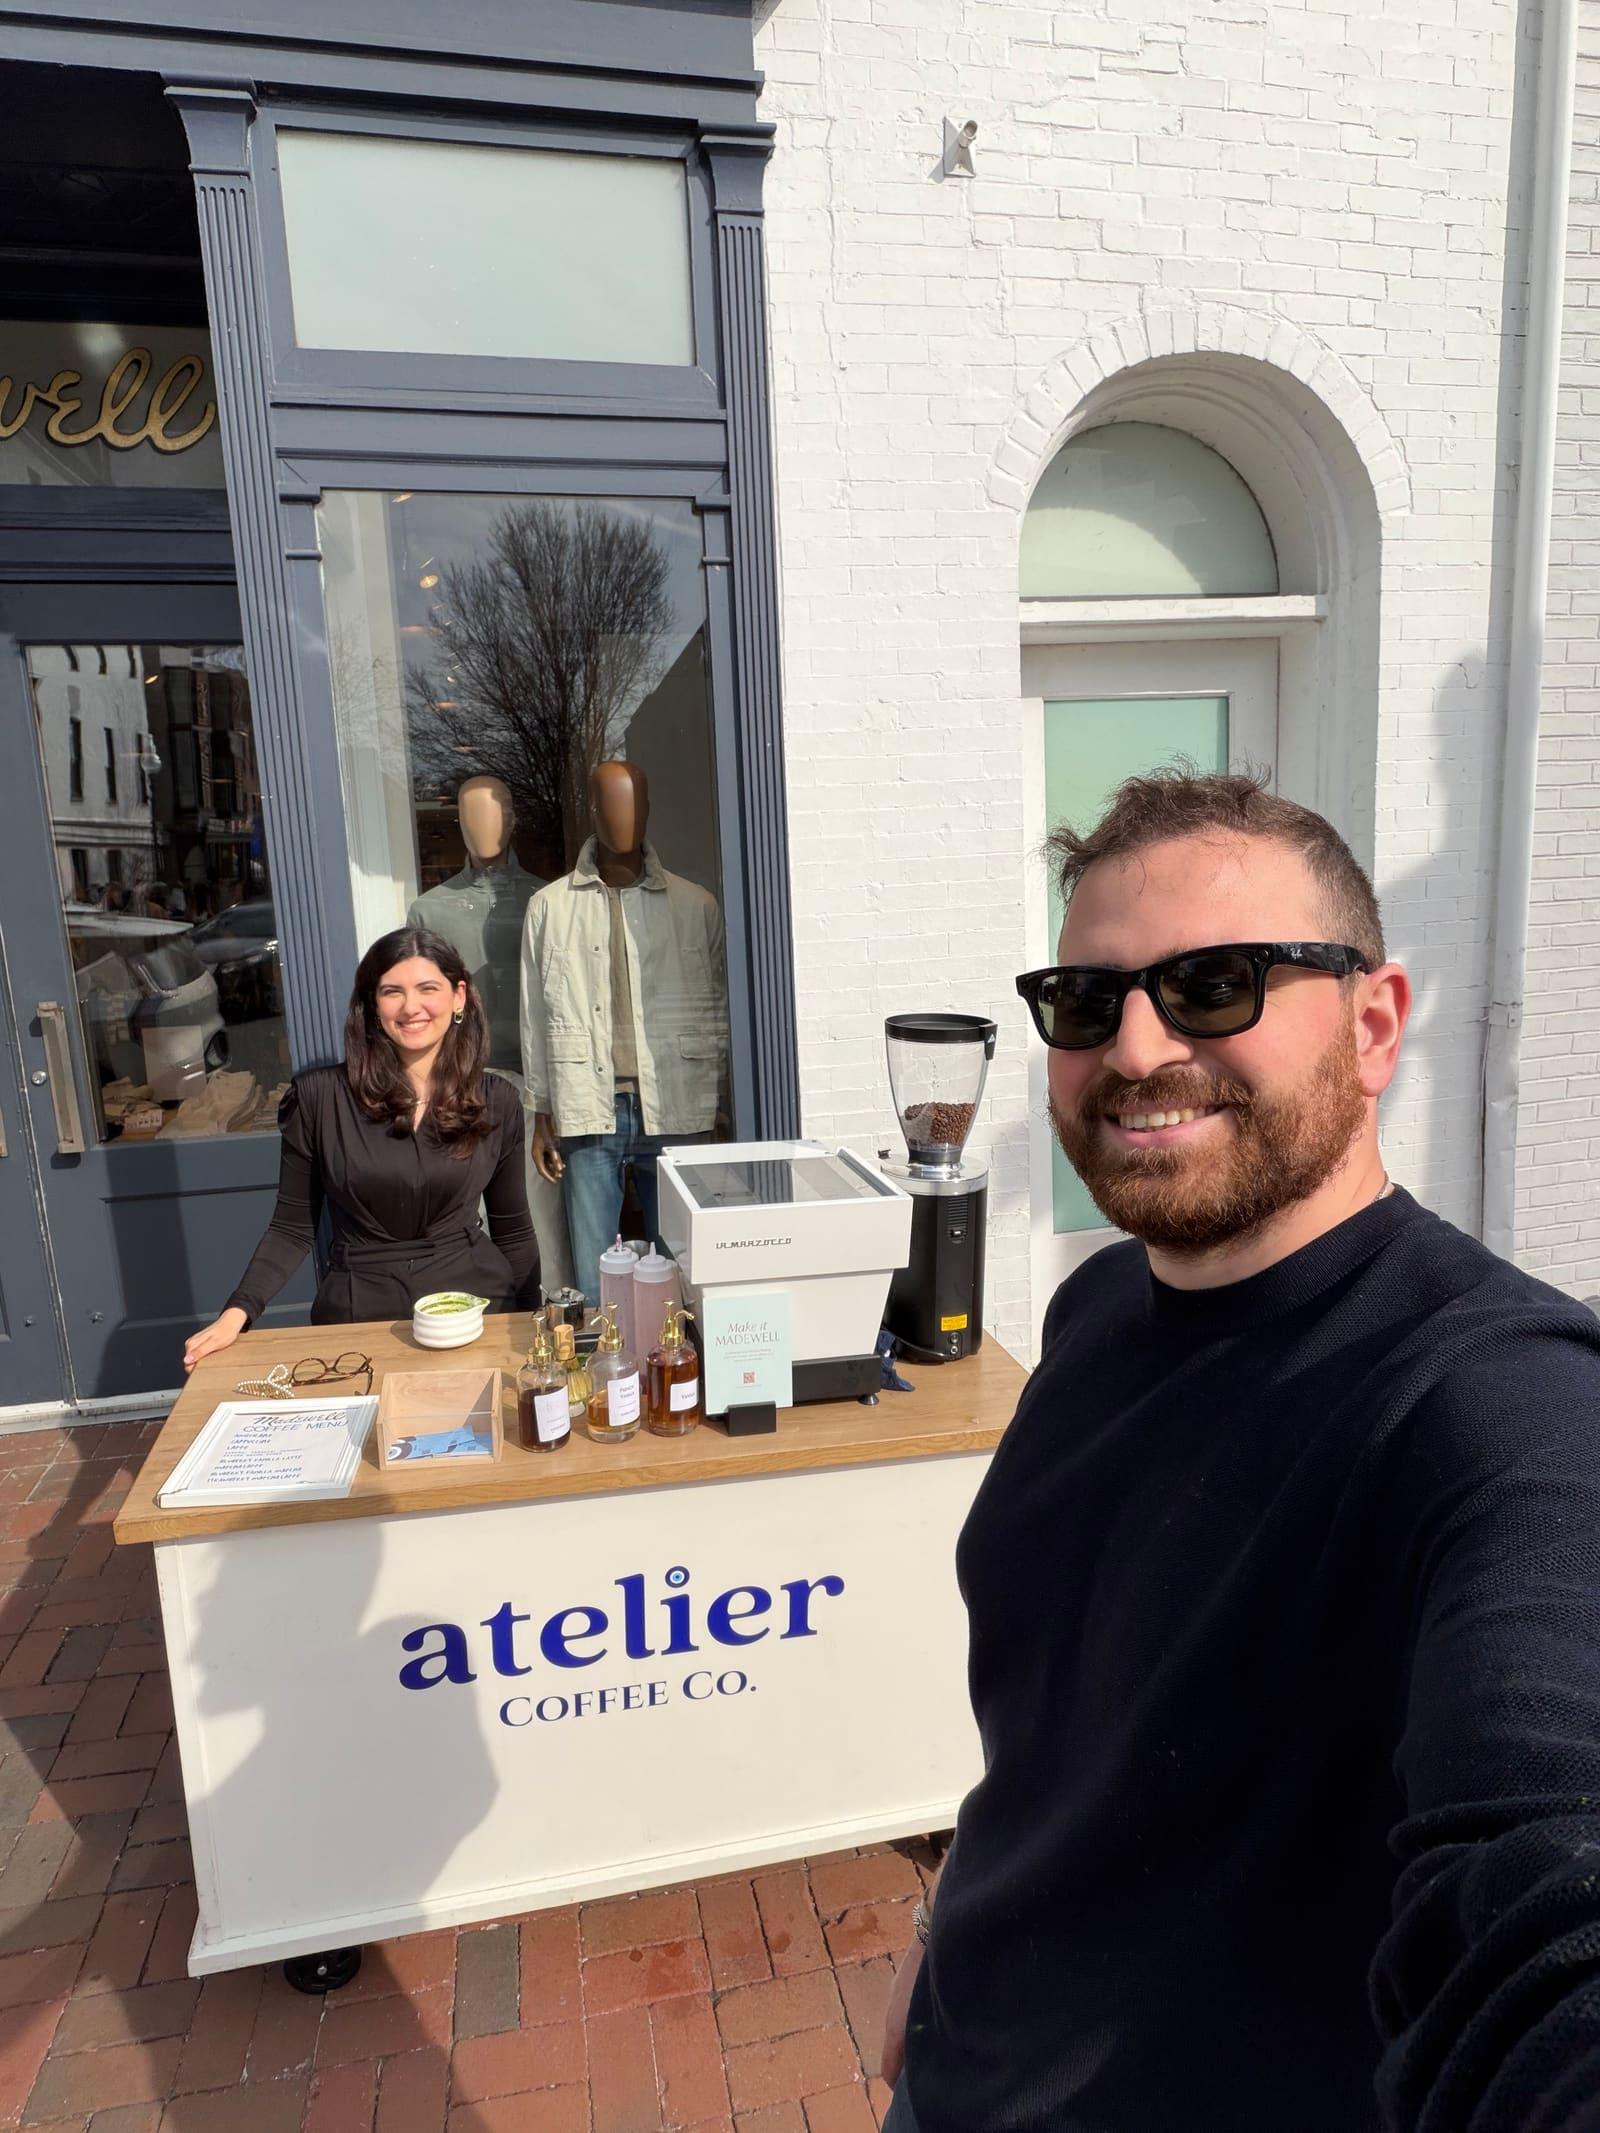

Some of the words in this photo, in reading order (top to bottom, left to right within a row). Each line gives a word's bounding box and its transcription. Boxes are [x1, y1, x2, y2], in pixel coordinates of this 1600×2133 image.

[728, 1321, 757, 1334] Make
[760, 1320, 768, 1331] it
[715, 1330, 781, 1346] MADEWELL
[243, 1423, 300, 1433] COFFEE
[306, 1419, 350, 1430] MENU
[253, 1411, 346, 1426] Madewell
[399, 1565, 845, 1690] atelier
[499, 1680, 669, 1728] COFFEE
[682, 1669, 757, 1701] CO.
